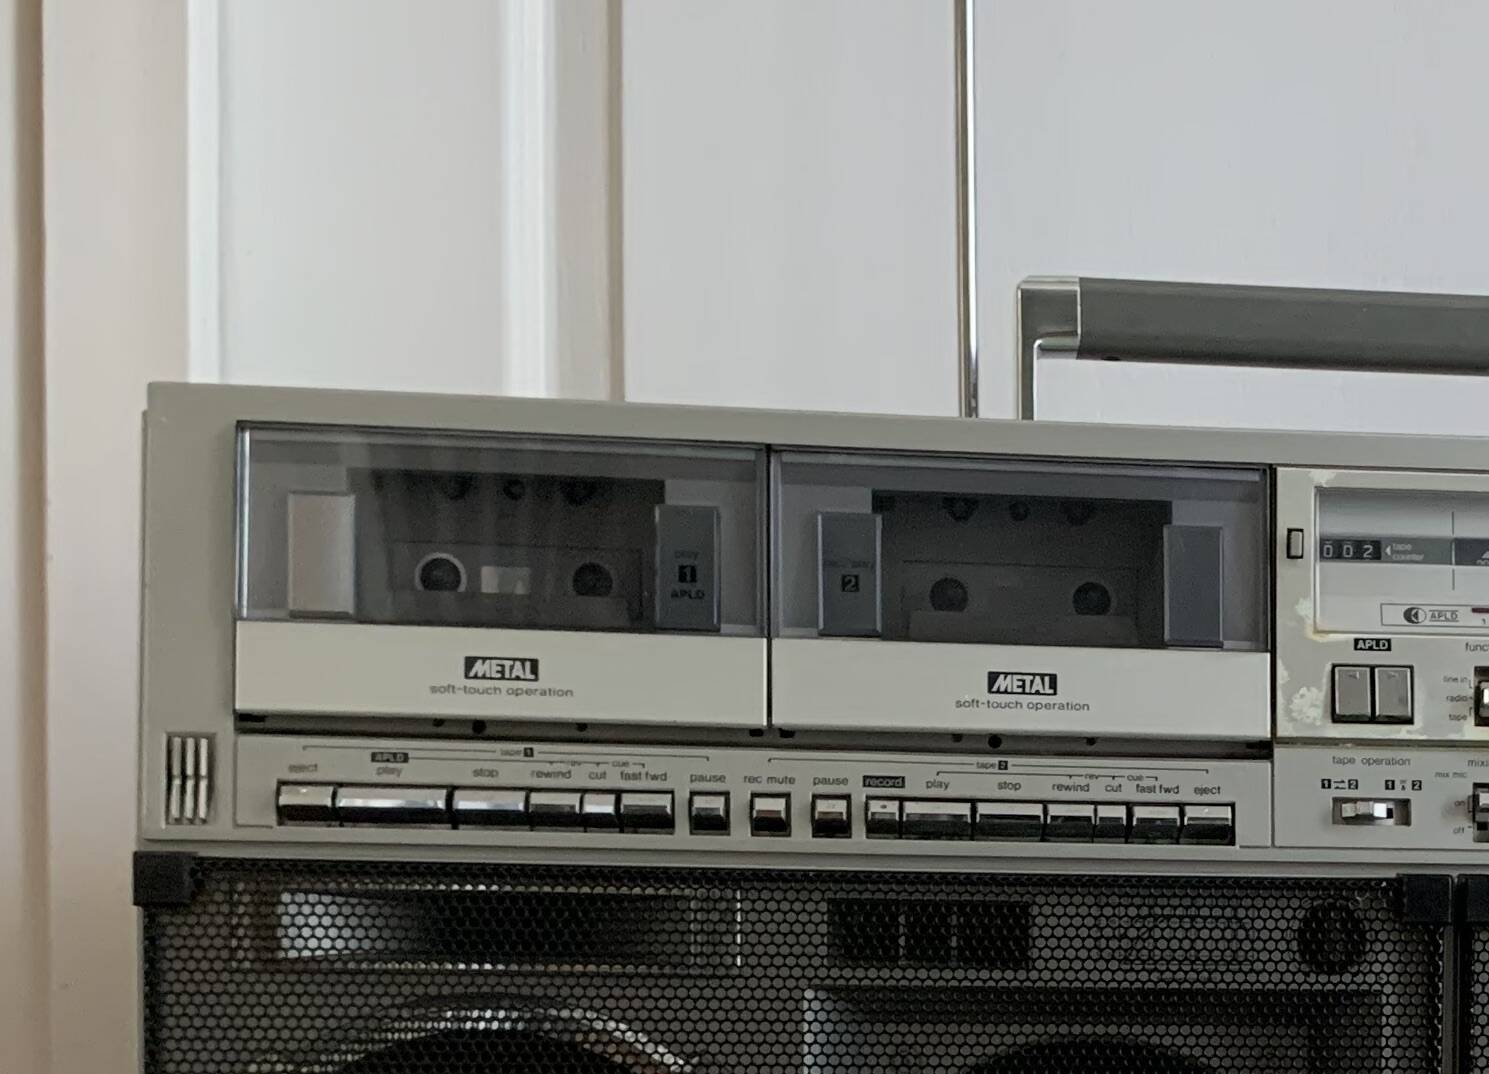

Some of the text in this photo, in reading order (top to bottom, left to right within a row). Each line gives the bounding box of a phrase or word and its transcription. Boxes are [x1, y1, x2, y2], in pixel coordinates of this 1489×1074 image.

[1429, 611, 1459, 621] APLD
[1355, 639, 1390, 651] APLD
[467, 658, 538, 681] METAL
[990, 673, 1055, 695] METAL
[429, 683, 574, 698] soft-touch operation
[955, 698, 1090, 712] soft-touch operation
[1332, 756, 1411, 767] tape operation
[472, 766, 499, 779] stop
[531, 769, 572, 780] rewind
[588, 770, 607, 780] cut
[620, 769, 668, 782] fast fwd
[689, 773, 726, 785] pause
[743, 773, 796, 786] rec mute
[812, 776, 849, 788] pause
[864, 776, 904, 788] record
[925, 778, 950, 791] play
[1321, 779, 1359, 790] 1 2
[1385, 779, 1422, 791] 1 2
[997, 779, 1022, 792] stop
[1051, 782, 1090, 793] rewind
[1104, 783, 1122, 793] cut
[1135, 783, 1180, 795] fast fwd
[1193, 785, 1221, 797] eject
